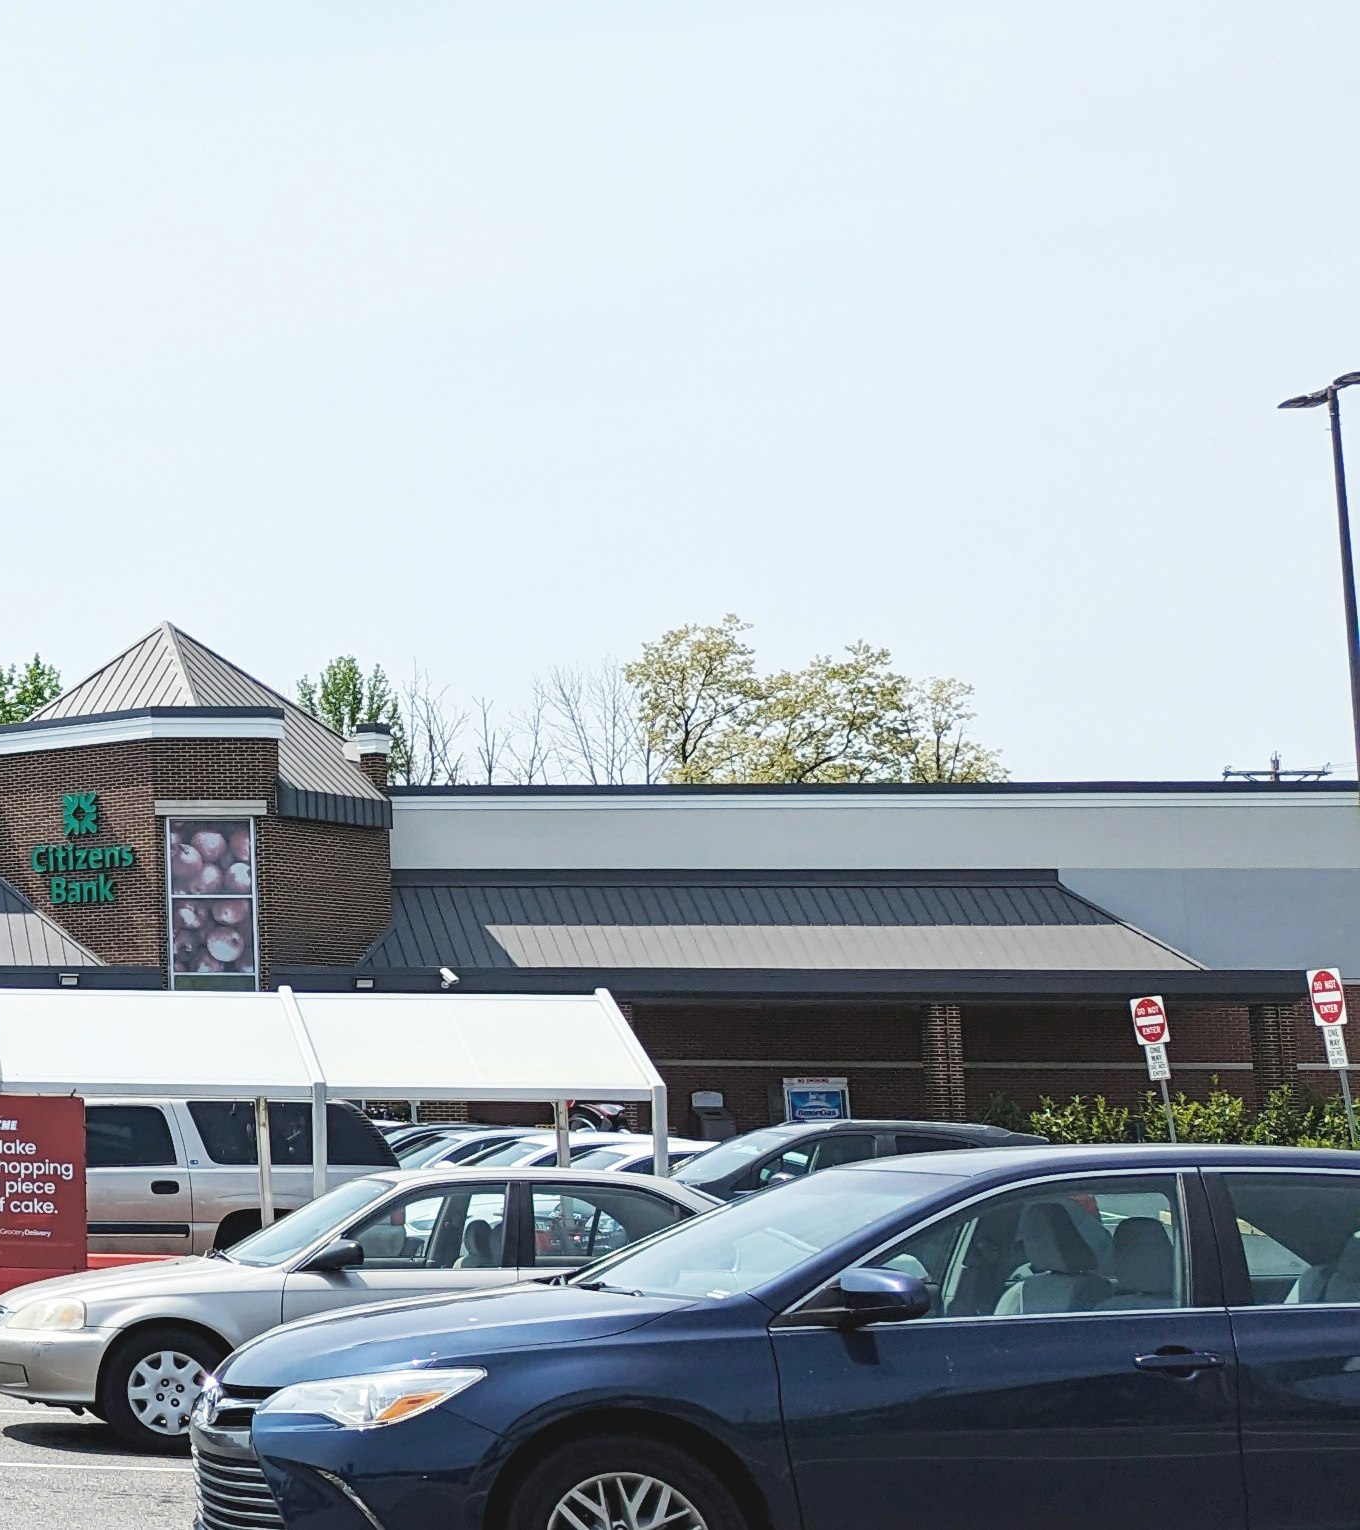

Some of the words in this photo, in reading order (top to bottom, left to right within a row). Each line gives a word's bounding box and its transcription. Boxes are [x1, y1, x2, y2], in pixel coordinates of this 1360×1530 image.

[31, 843, 134, 873] Citizens
[51, 873, 115, 904] Bank
[1314, 981, 1322, 990] DO
[1324, 980, 1336, 989] NOT
[1147, 1006, 1158, 1014] NOT
[1328, 1029, 1339, 1037] ONE
[1329, 1039, 1340, 1047] WAY
[5, 1178, 56, 1198] piece
[10, 1198, 58, 1214] cake.
